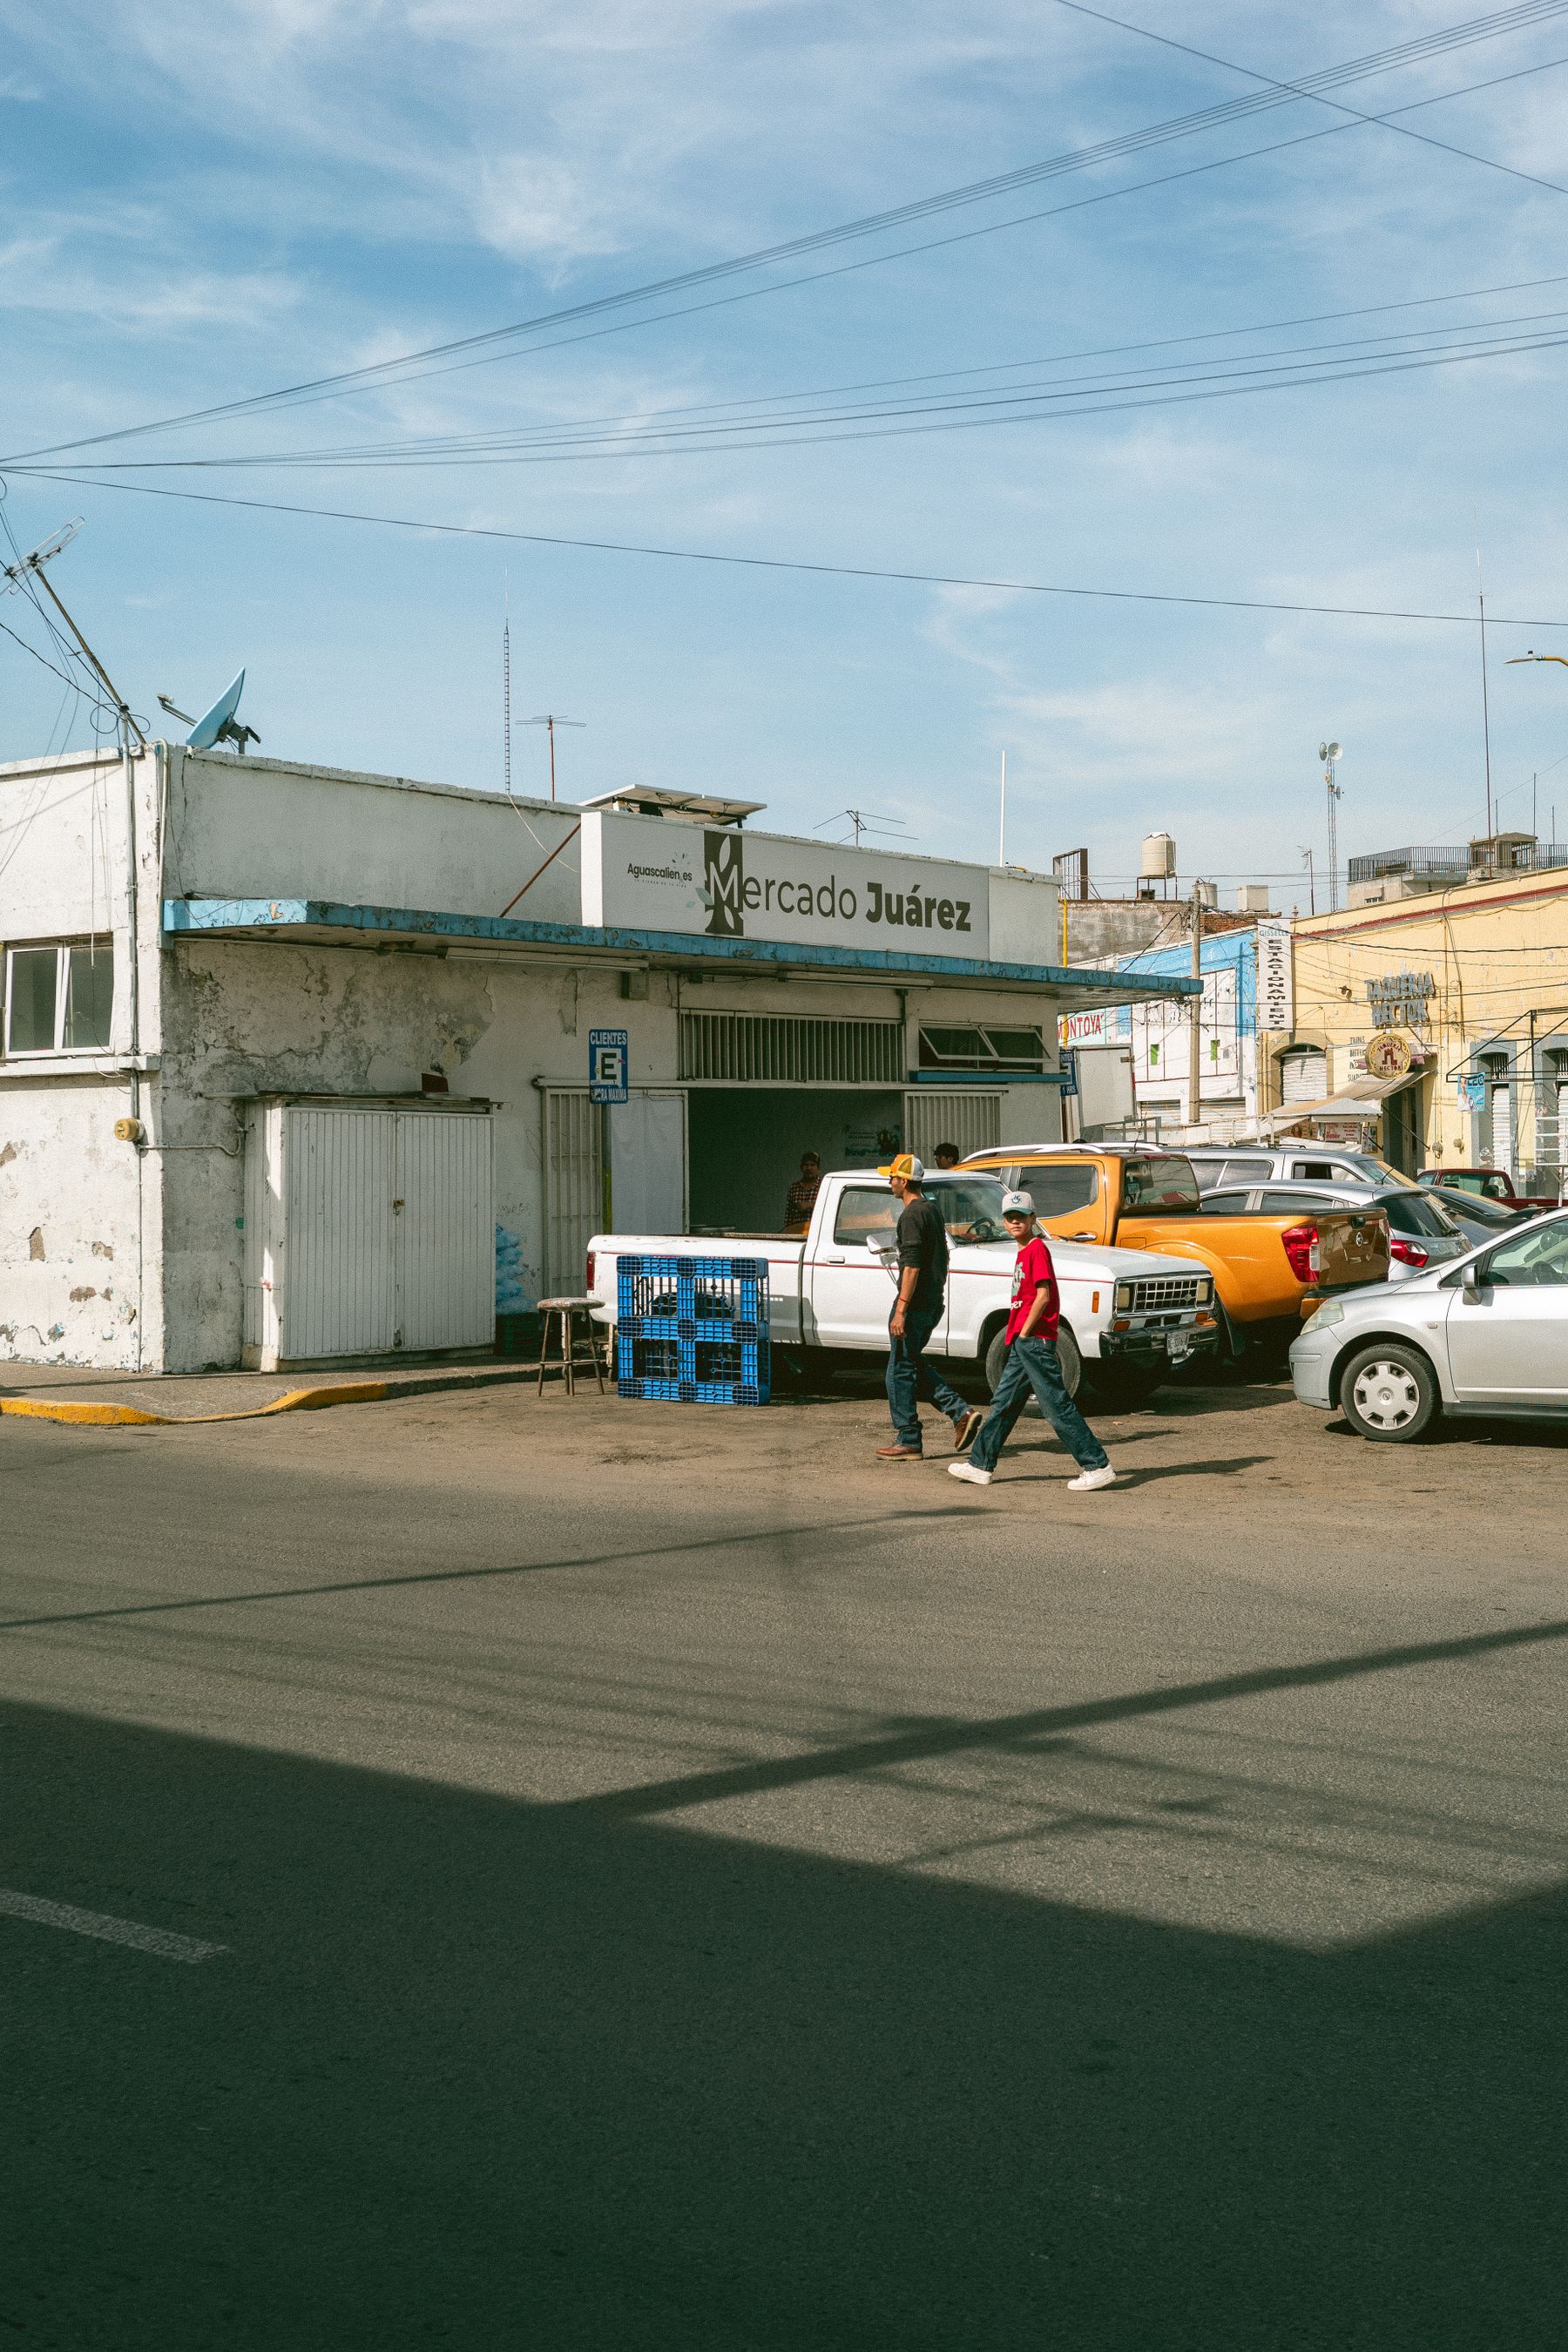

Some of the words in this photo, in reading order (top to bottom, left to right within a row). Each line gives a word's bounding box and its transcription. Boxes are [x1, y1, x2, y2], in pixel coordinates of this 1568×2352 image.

[627, 862, 693, 882] Aguascalienes
[709, 861, 857, 920] Mercado
[865, 881, 971, 932] Juárez
[1267, 939, 1286, 1031] ESTACIONAMIENTO
[1364, 970, 1436, 1002] TAQUERIA
[1371, 998, 1430, 1028] HECTOR
[590, 1031, 627, 1045] CLIENTES
[1377, 1042, 1401, 1052] TAQUERIA
[601, 1052, 617, 1079] E
[608, 1087, 627, 1102] MAXIMA
